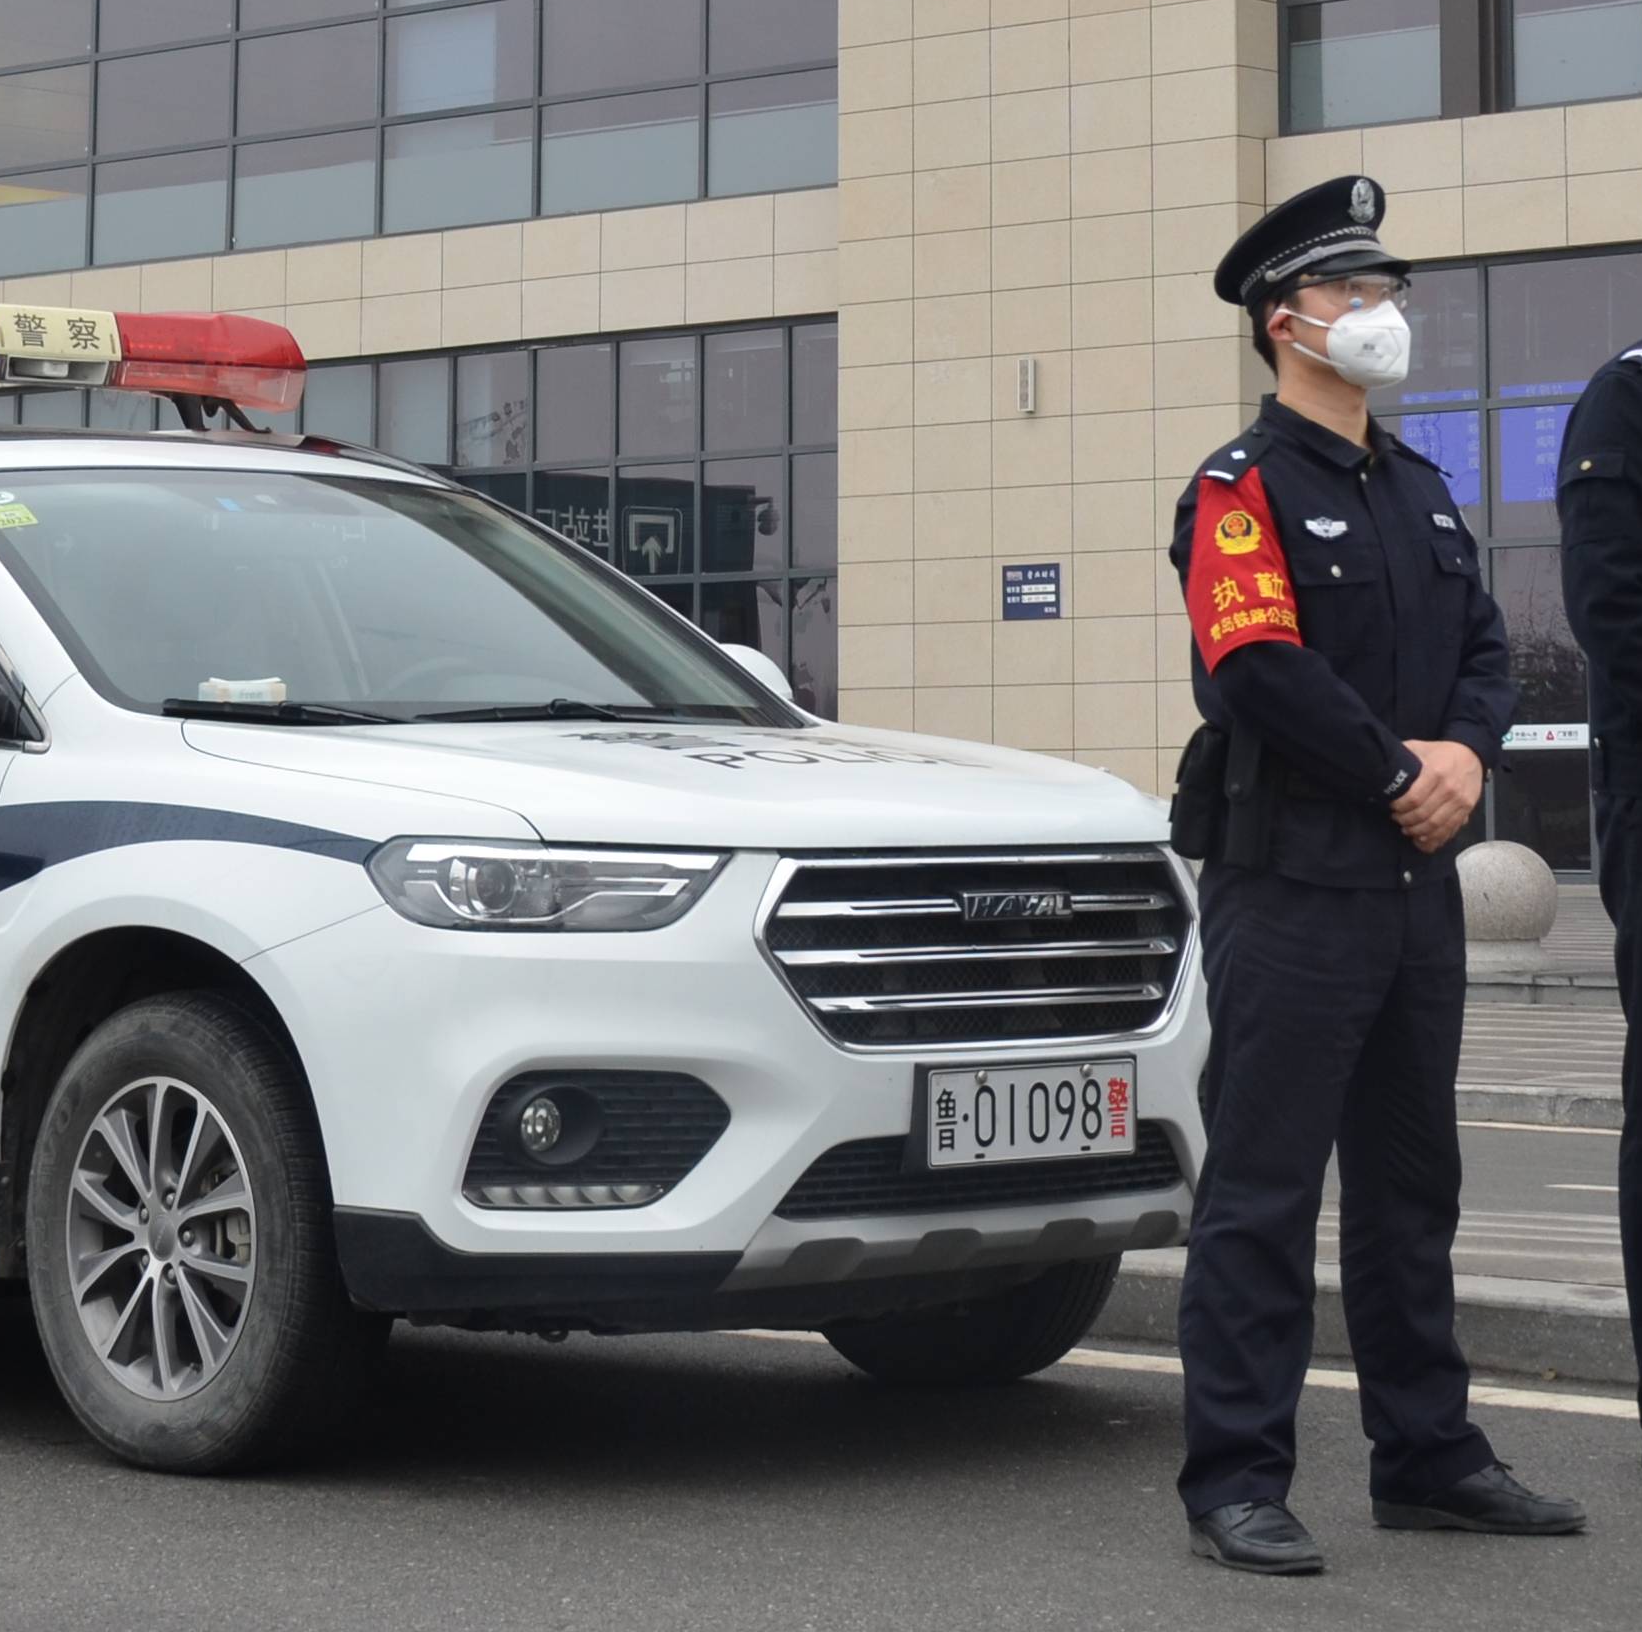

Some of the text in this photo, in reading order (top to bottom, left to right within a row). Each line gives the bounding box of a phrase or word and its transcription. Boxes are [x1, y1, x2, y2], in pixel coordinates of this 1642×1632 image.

[13, 313, 100, 350] 警察
[1212, 572, 1285, 612] 执勤
[1210, 606, 1298, 643] 青岛铁路公安
[970, 894, 1072, 917] HAVAL
